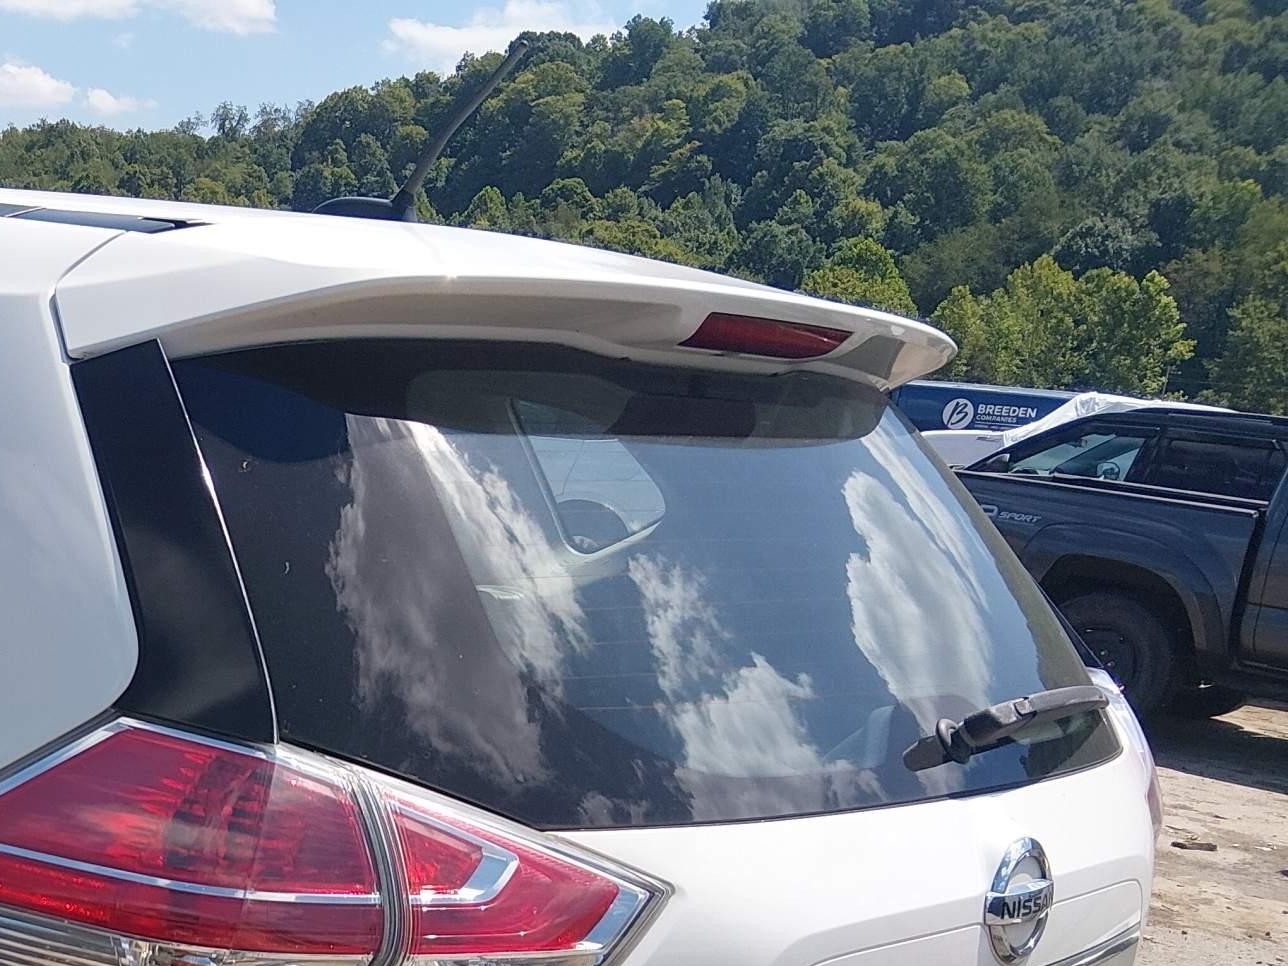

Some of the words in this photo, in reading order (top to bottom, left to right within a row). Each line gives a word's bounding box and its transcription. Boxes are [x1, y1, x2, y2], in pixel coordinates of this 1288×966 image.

[977, 404, 1037, 418] BREEDEN
[976, 414, 1017, 423] COMPANIES
[999, 511, 1042, 522] SPORT
[1000, 890, 1053, 920] NISSAN
